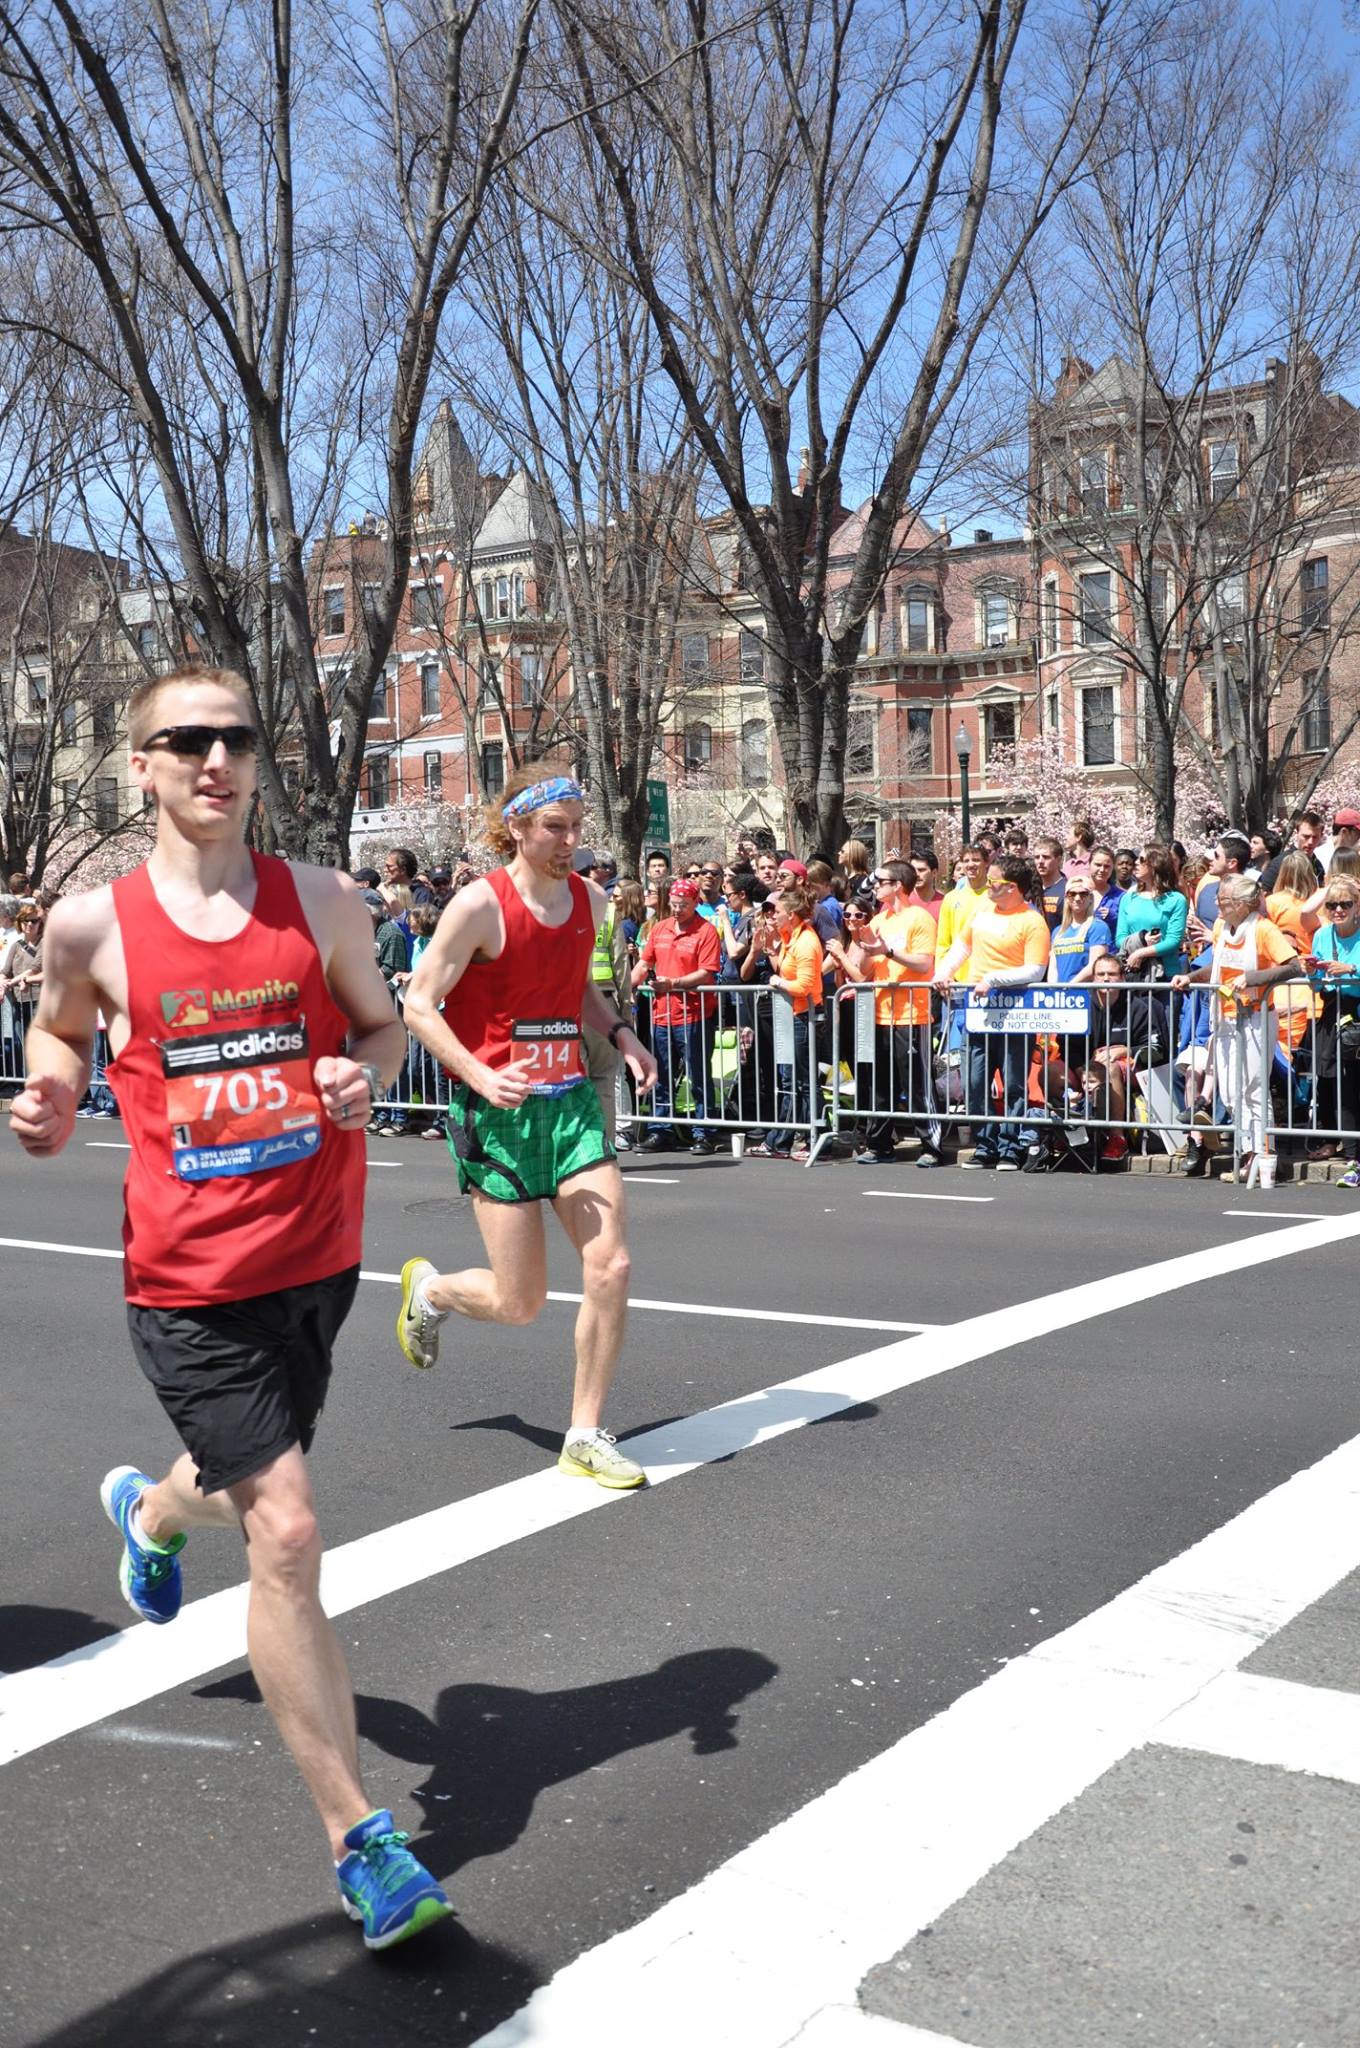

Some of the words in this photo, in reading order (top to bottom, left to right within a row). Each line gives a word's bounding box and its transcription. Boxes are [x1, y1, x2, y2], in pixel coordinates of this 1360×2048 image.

[212, 980, 298, 1010] Manito
[968, 991, 1024, 1009] Boston
[1032, 990, 1085, 1009] Police
[999, 1012, 1028, 1020] POLICE
[1033, 1012, 1053, 1020] LINE
[543, 1022, 578, 1035] adidas
[991, 1021, 1004, 1030] DO
[1008, 1021, 1027, 1030] NOT
[1029, 1021, 1061, 1030] CROSS
[222, 1032, 303, 1059] adidas
[527, 1043, 569, 1068] 214
[195, 1067, 288, 1120] 705
[219, 1147, 251, 1159] BOSTON
[200, 1155, 252, 1169] MARATHON
